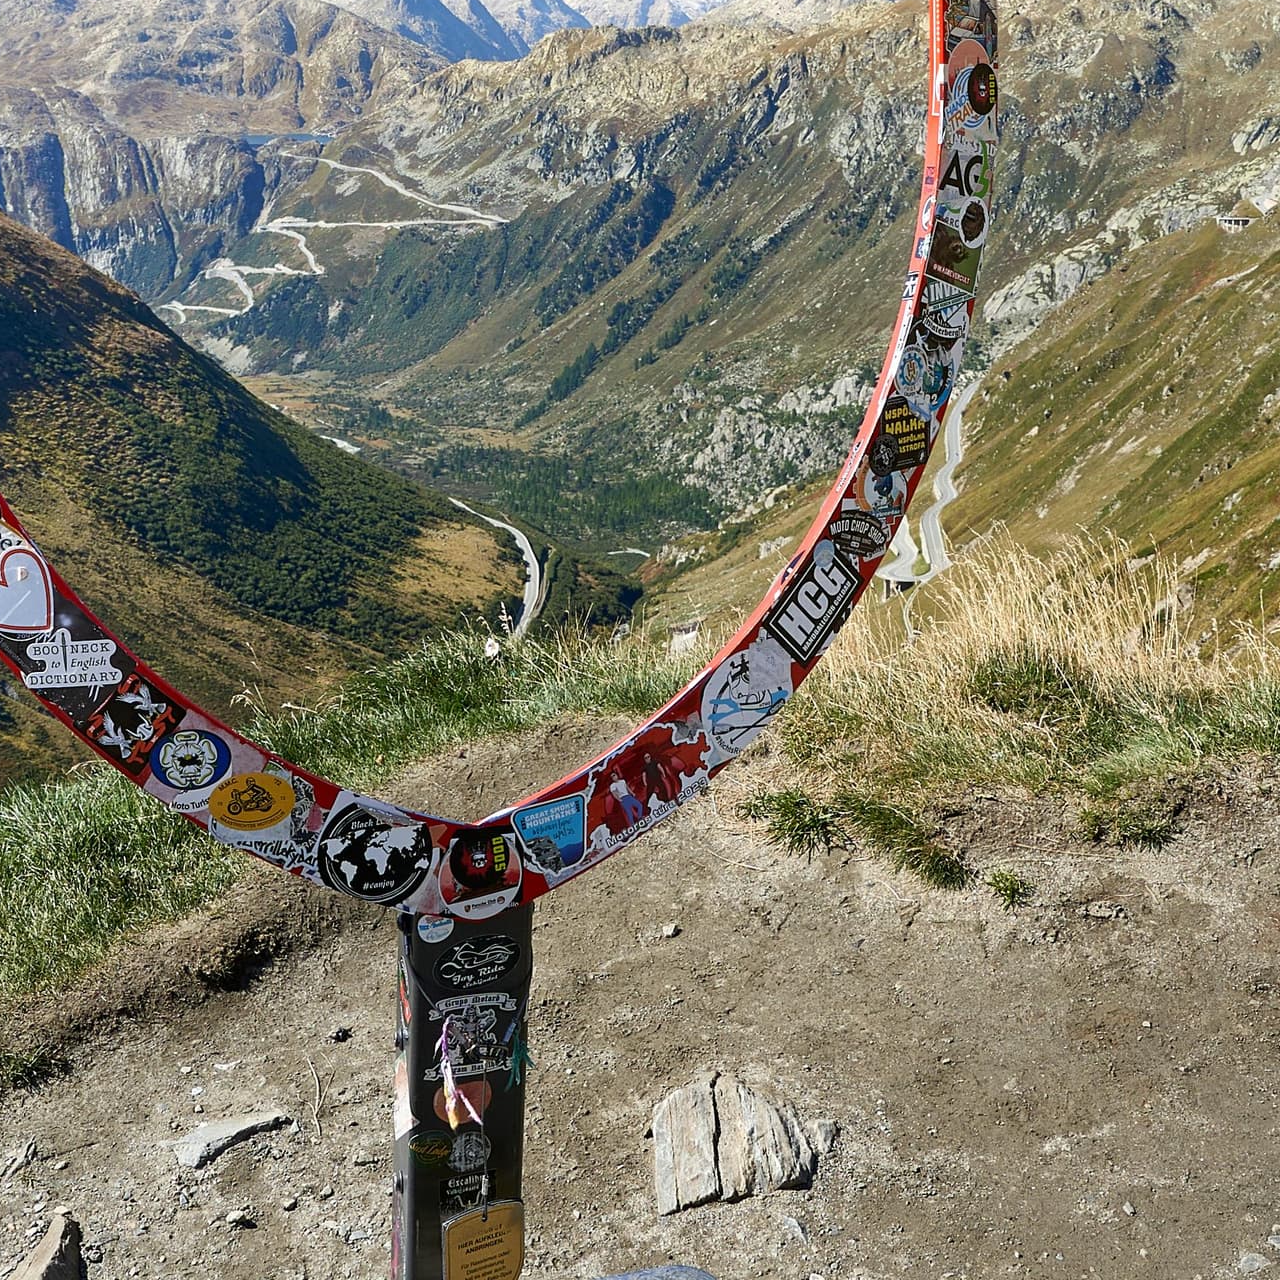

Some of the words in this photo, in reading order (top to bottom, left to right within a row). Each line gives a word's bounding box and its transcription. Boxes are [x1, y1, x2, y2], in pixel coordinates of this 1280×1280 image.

[830, 520, 850, 535] MOTO
[851, 519, 869, 534] CHOP
[869, 526, 887, 546] SHOP
[777, 562, 847, 647] HCG
[801, 603, 836, 652] HANDBALLCLUB
[51, 660, 61, 669] to
[70, 657, 107, 671] English
[30, 671, 119, 686] DICTIONARY
[171, 801, 190, 810] Moto
[191, 797, 210, 810] Turis
[525, 810, 549, 822] GREAT
[526, 809, 577, 829] MOUNTAINS
[606, 814, 651, 848] Motoros
[676, 776, 708, 802] 2023
[351, 820, 373, 830] Black
[479, 965, 506, 976] Ride
